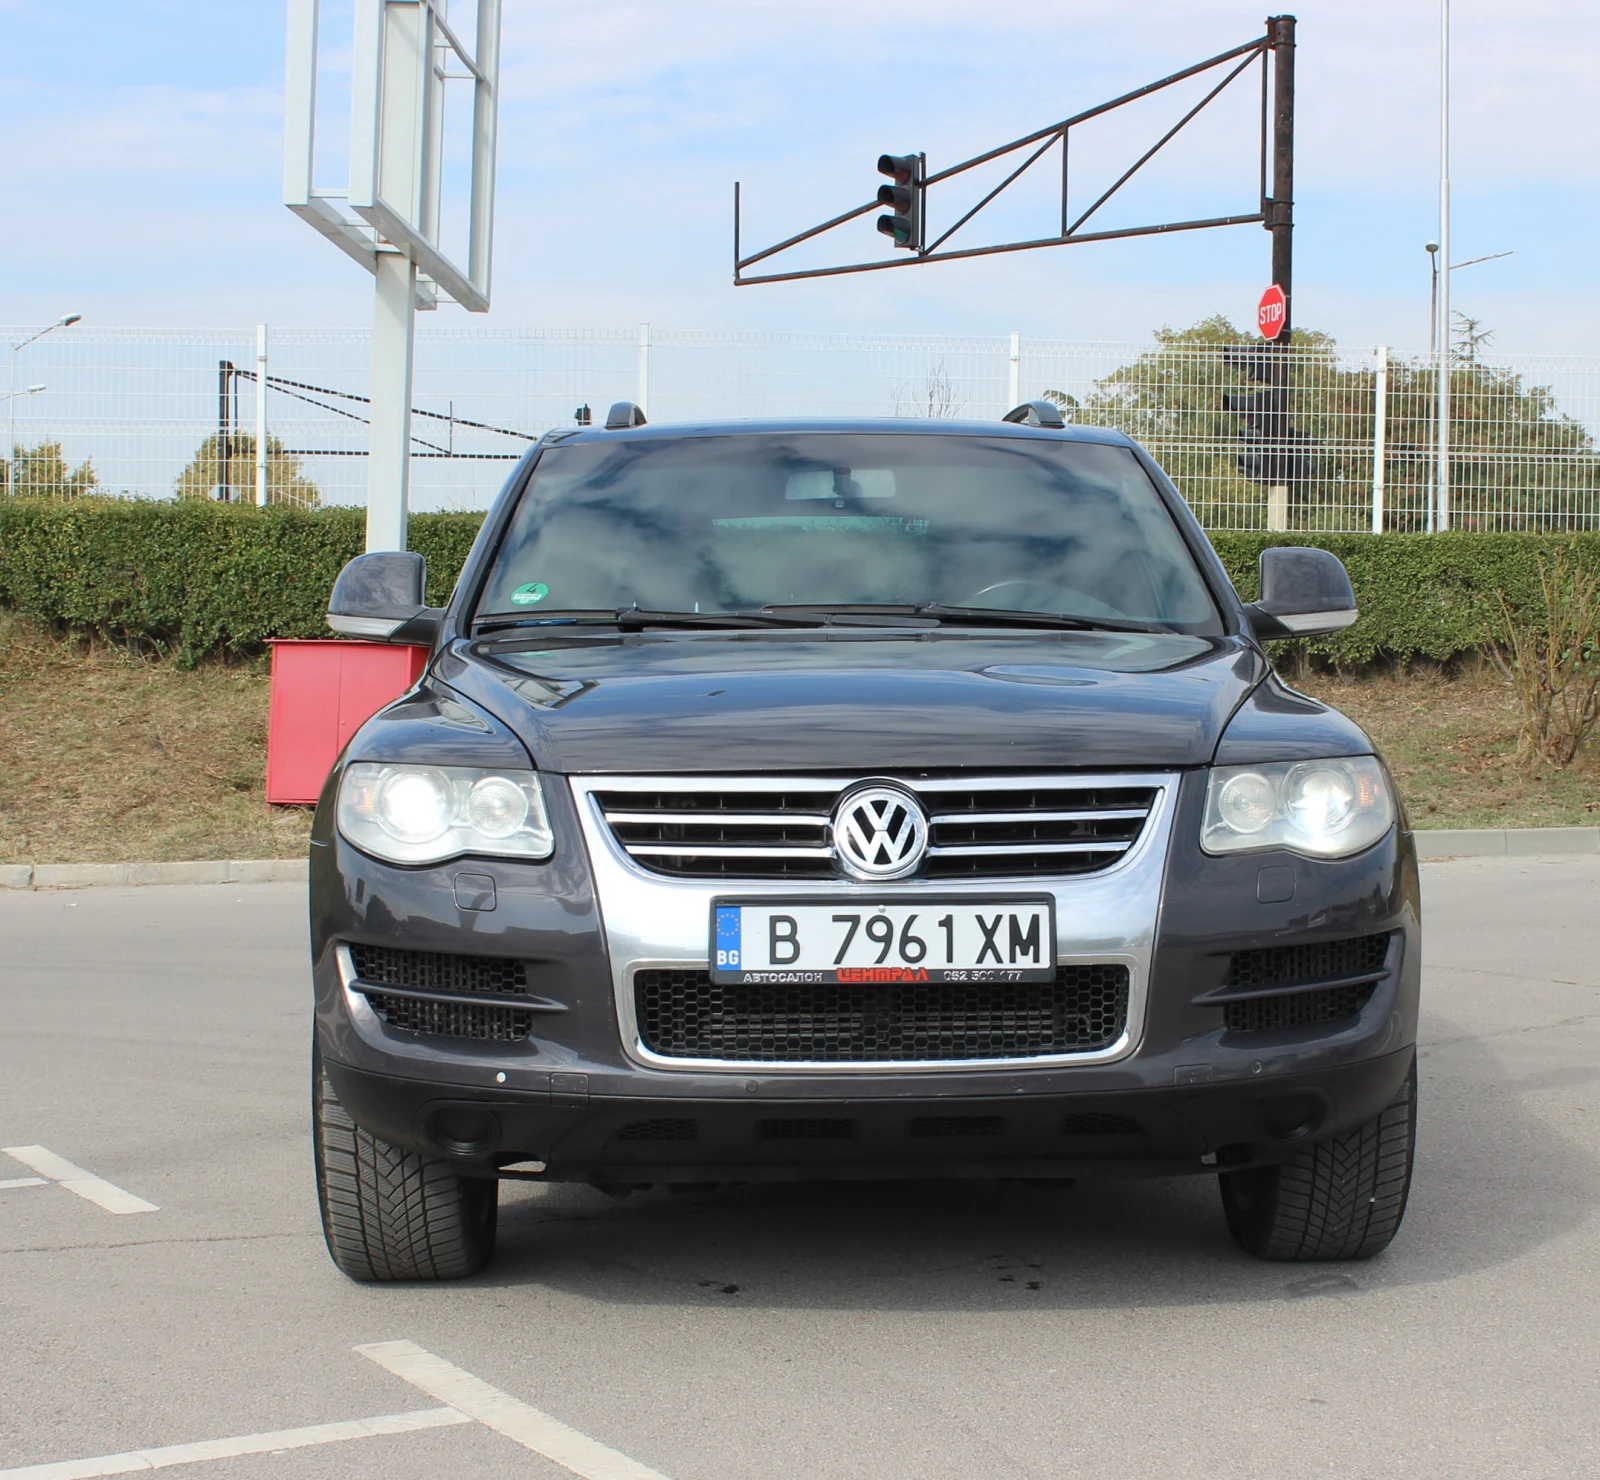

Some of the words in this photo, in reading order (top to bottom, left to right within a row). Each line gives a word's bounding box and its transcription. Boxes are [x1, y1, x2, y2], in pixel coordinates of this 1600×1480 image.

[1260, 302, 1282, 325] STOP
[769, 915, 800, 964] B
[832, 914, 953, 964] 7961
[975, 914, 1040, 964] XM
[716, 950, 740, 966] BG
[743, 972, 823, 983] АВТОСАЛОН
